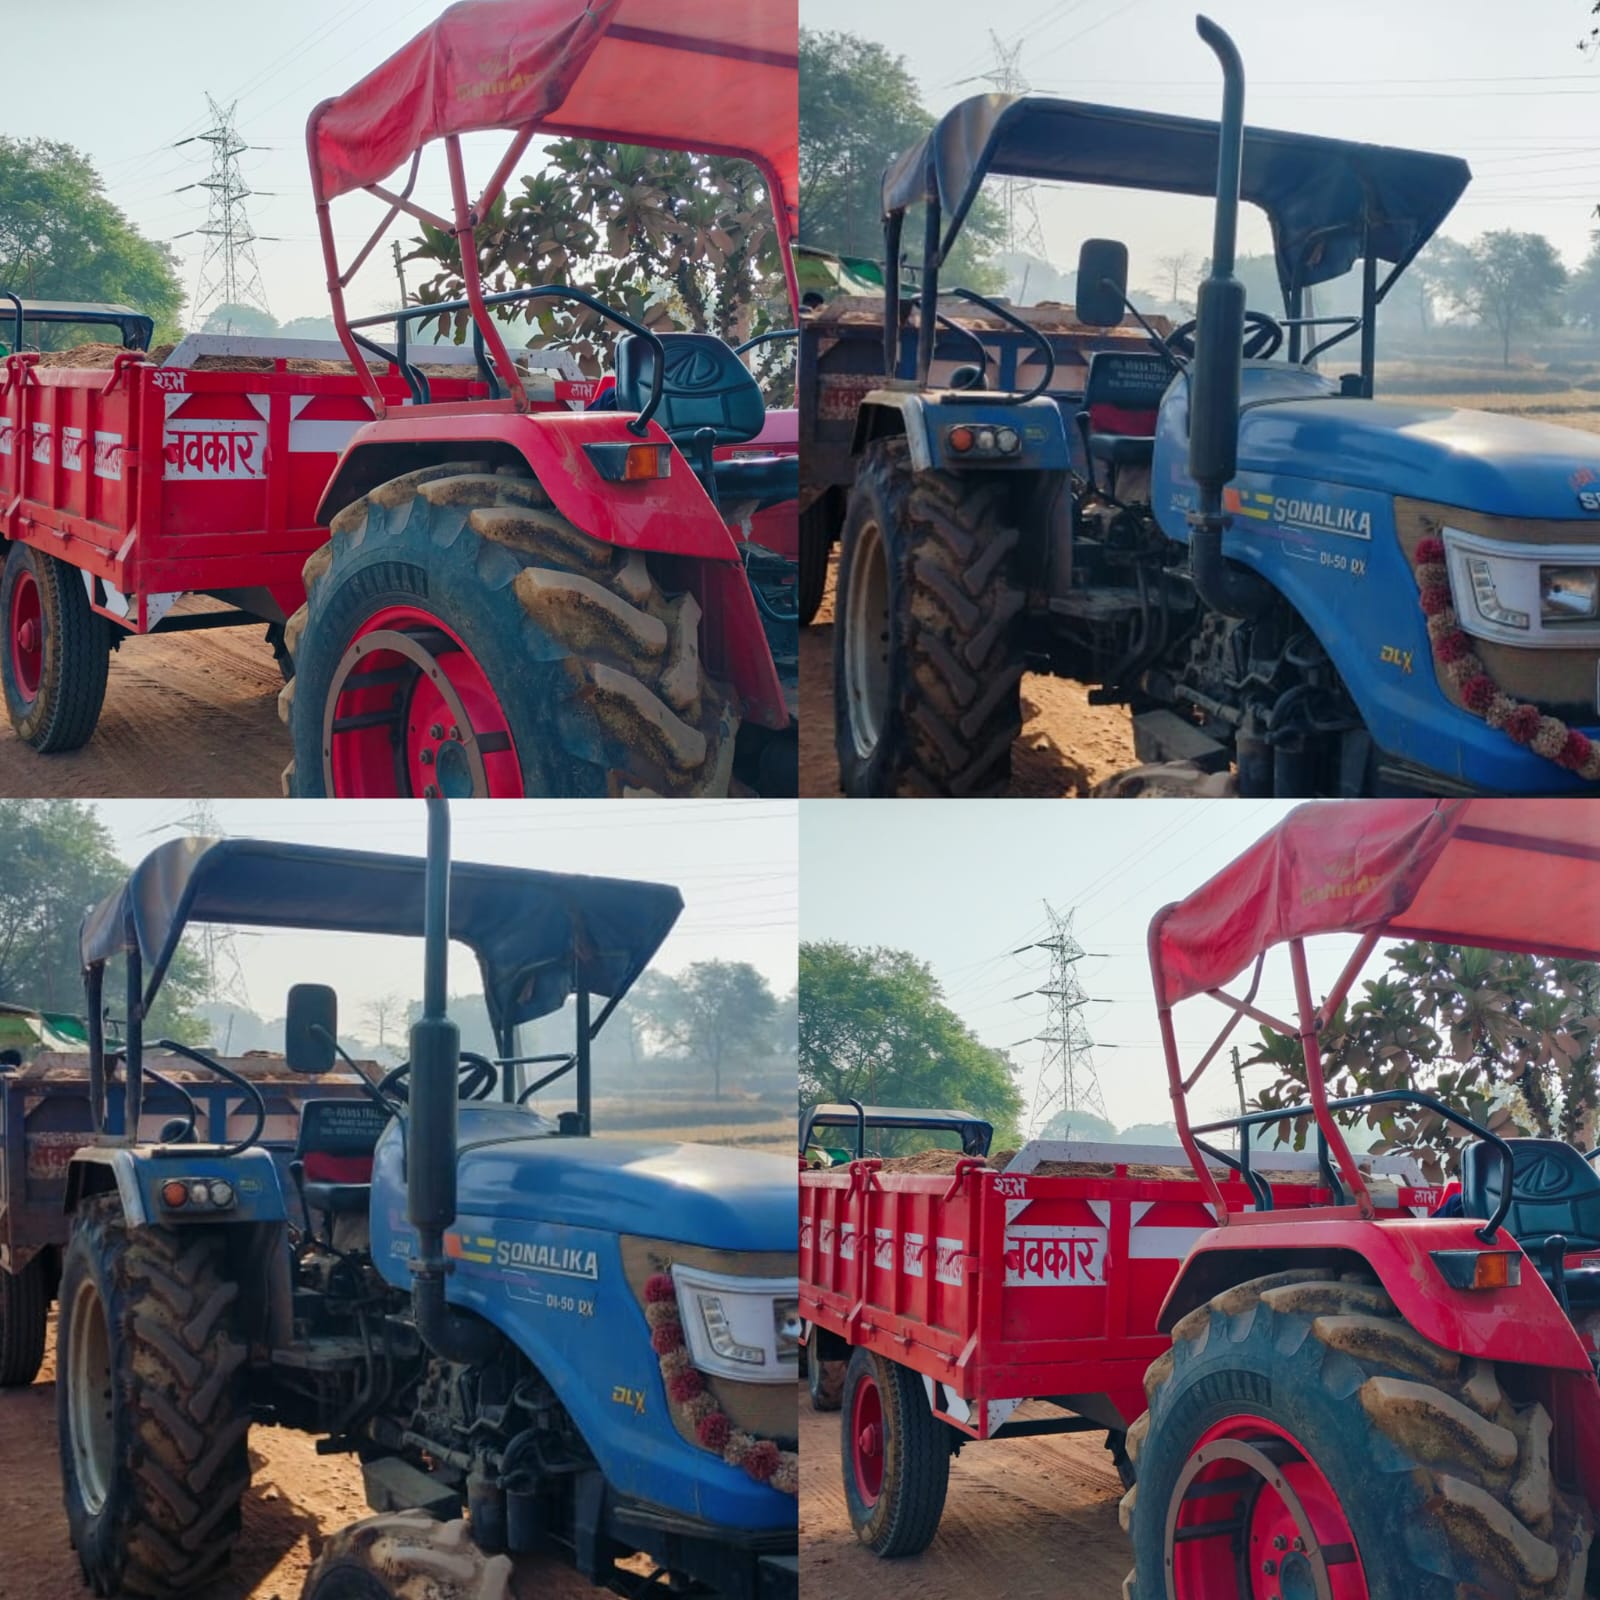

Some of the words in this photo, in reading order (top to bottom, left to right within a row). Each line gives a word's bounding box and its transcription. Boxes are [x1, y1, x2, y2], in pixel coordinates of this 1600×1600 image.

[164, 430, 259, 475] नवकार
[1274, 498, 1372, 539] SONALIKA
[497, 1240, 598, 1280] SONALIKA
[1005, 1236, 1099, 1281] नवकार
